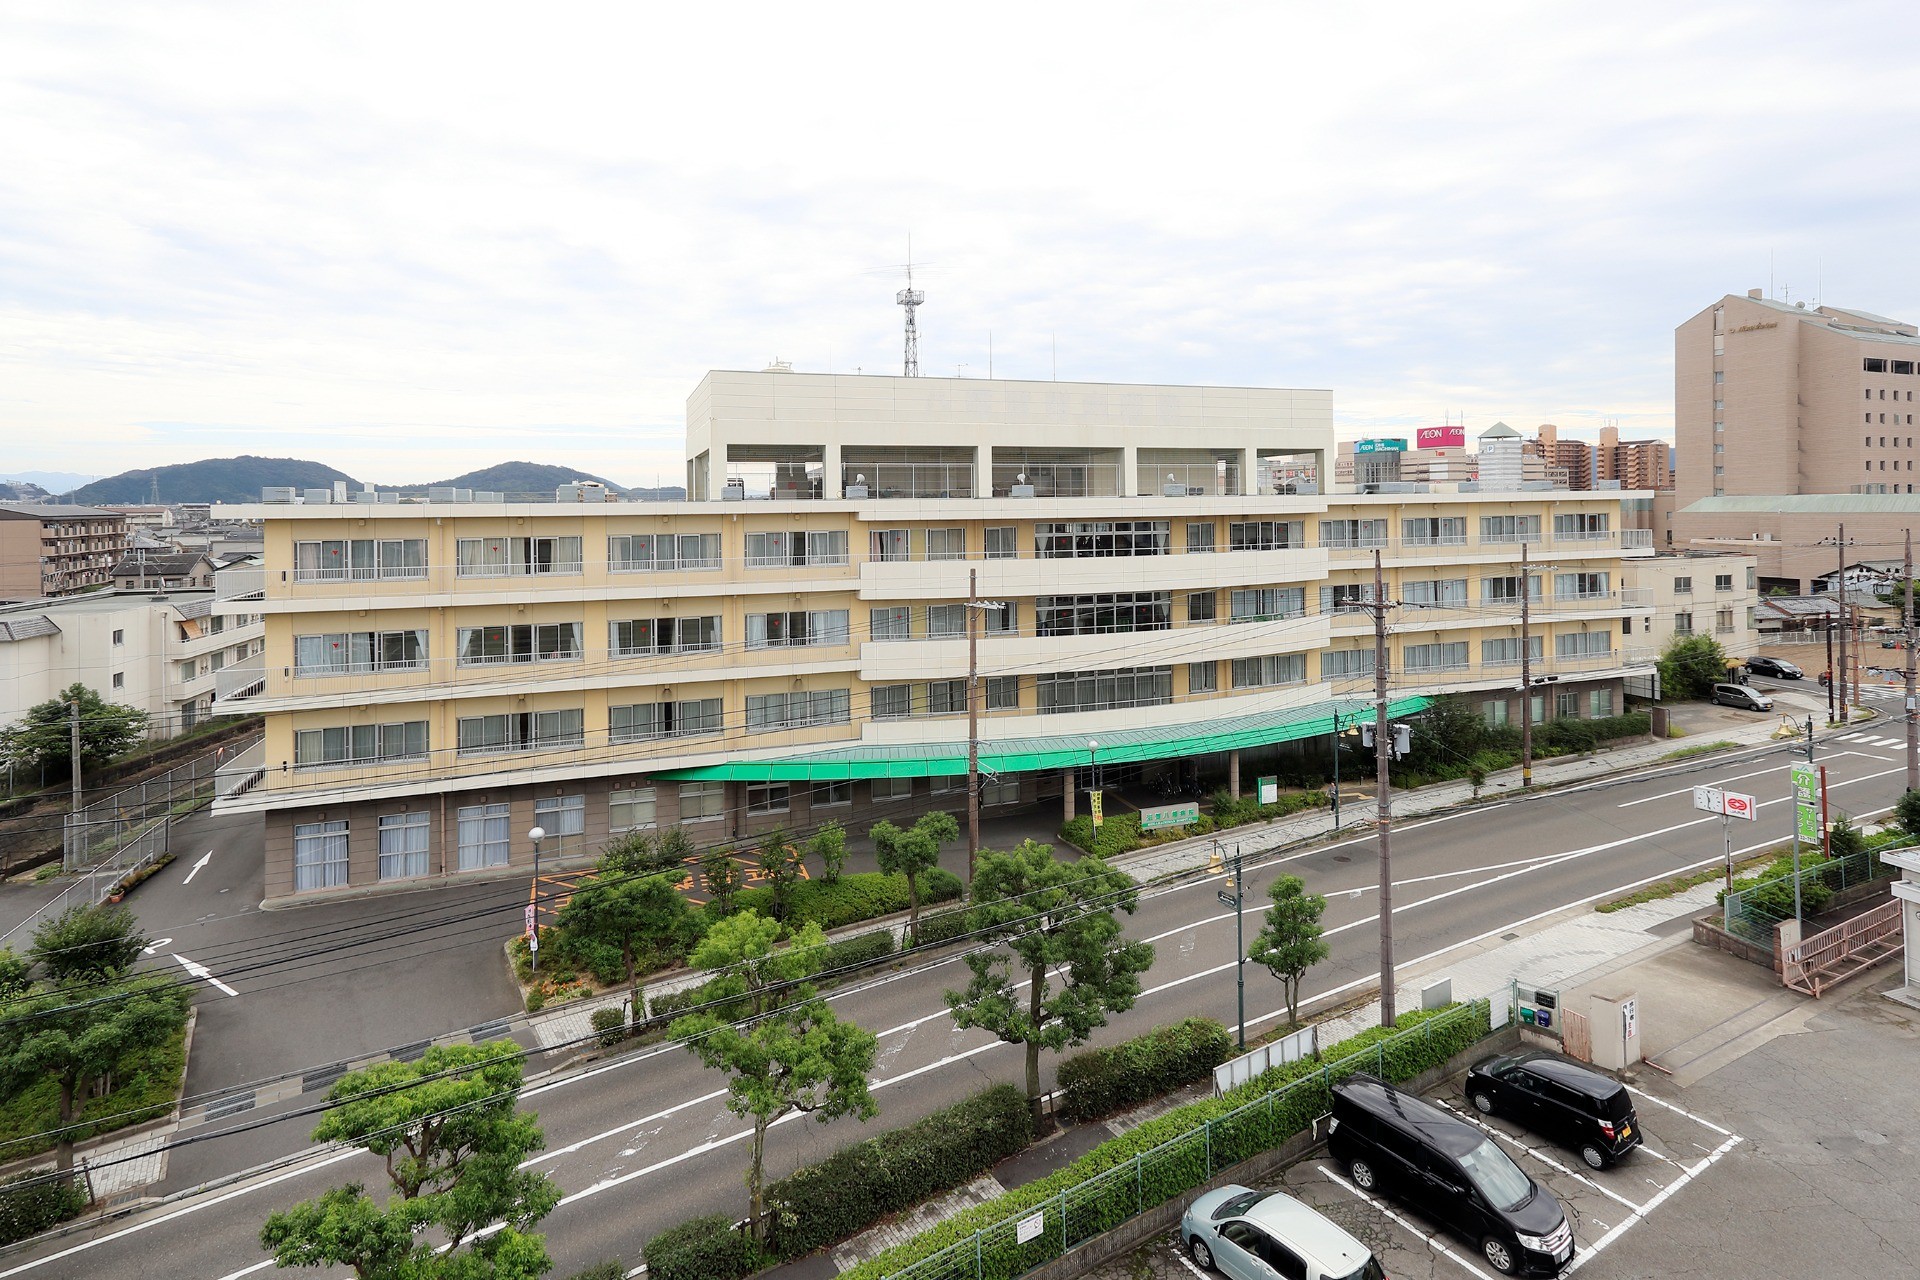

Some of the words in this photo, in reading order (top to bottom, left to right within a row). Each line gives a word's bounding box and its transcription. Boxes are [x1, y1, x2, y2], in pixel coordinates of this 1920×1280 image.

[1420, 429, 1442, 439] AEON
[1805, 808, 1815, 832] サービス
[1645, 1178, 1664, 1189] 2
[1592, 1218, 1611, 1230] 3
